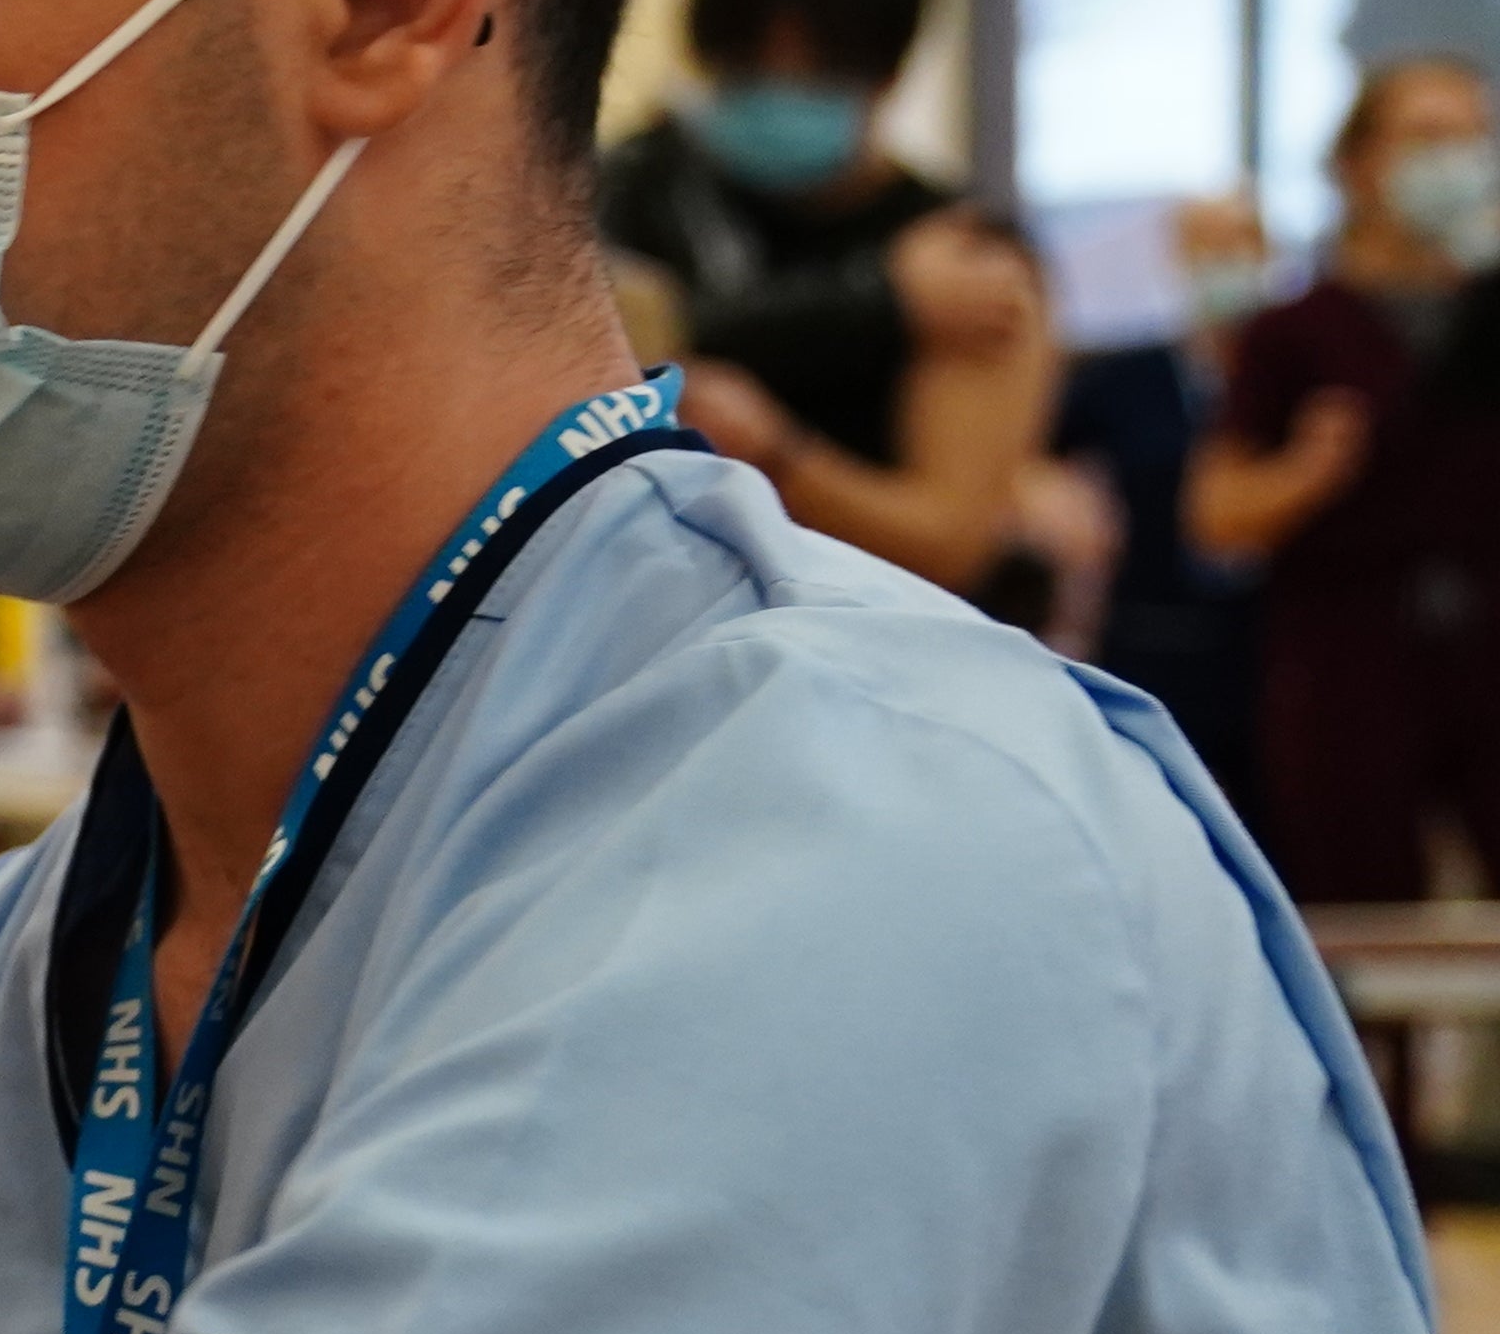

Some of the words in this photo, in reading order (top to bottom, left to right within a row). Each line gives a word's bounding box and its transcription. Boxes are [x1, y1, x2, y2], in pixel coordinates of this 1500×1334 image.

[556, 384, 662, 459] NHS
[92, 998, 142, 1120] NHS
[145, 1082, 204, 1217] NHS
[75, 1170, 136, 1307] NHS
